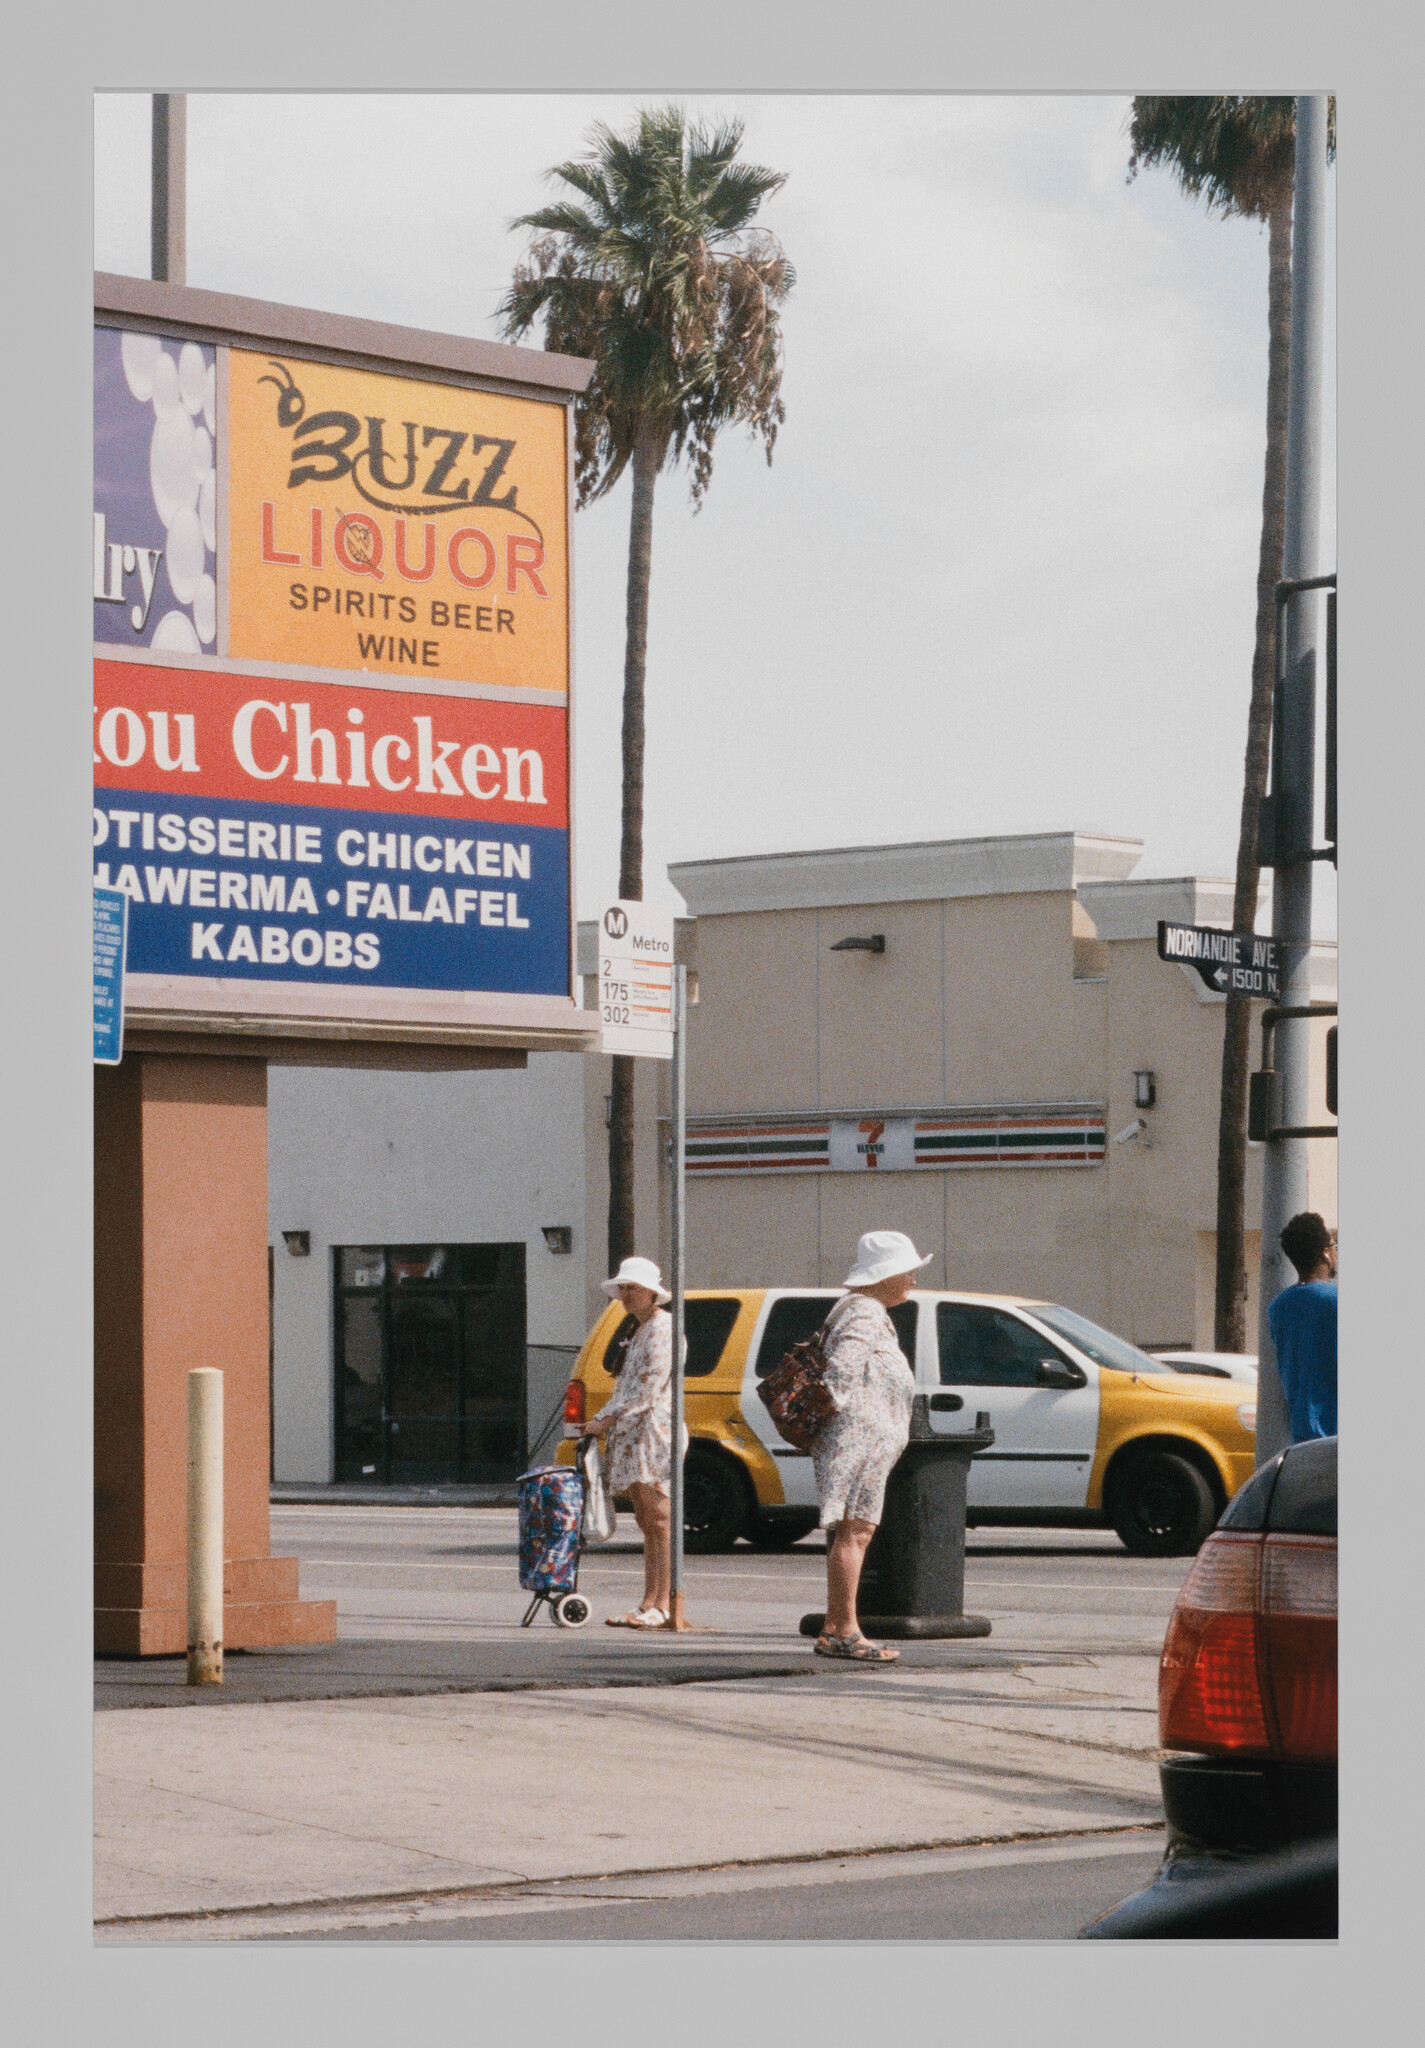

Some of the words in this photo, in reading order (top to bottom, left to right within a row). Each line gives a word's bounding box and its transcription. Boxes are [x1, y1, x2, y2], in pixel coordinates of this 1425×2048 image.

[286, 409, 519, 514] BUZZ
[261, 500, 551, 598] LIQUOR
[289, 583, 417, 623] SPIRITS
[430, 600, 516, 636] BEER
[357, 632, 440, 668] WINE
[94, 705, 200, 773] ou
[232, 698, 548, 804] Chicken
[336, 828, 531, 879] CHICKEN
[346, 880, 531, 929] FALAFEL
[190, 921, 380, 970] KABOBS
[633, 936, 669, 952] Metro
[1166, 928, 1242, 964] NORMANDIE
[603, 959, 612, 977] 2
[1232, 968, 1262, 991] 1500
[603, 982, 629, 1002] 175
[603, 1005, 630, 1025] 302
[858, 1121, 885, 1168] 7
